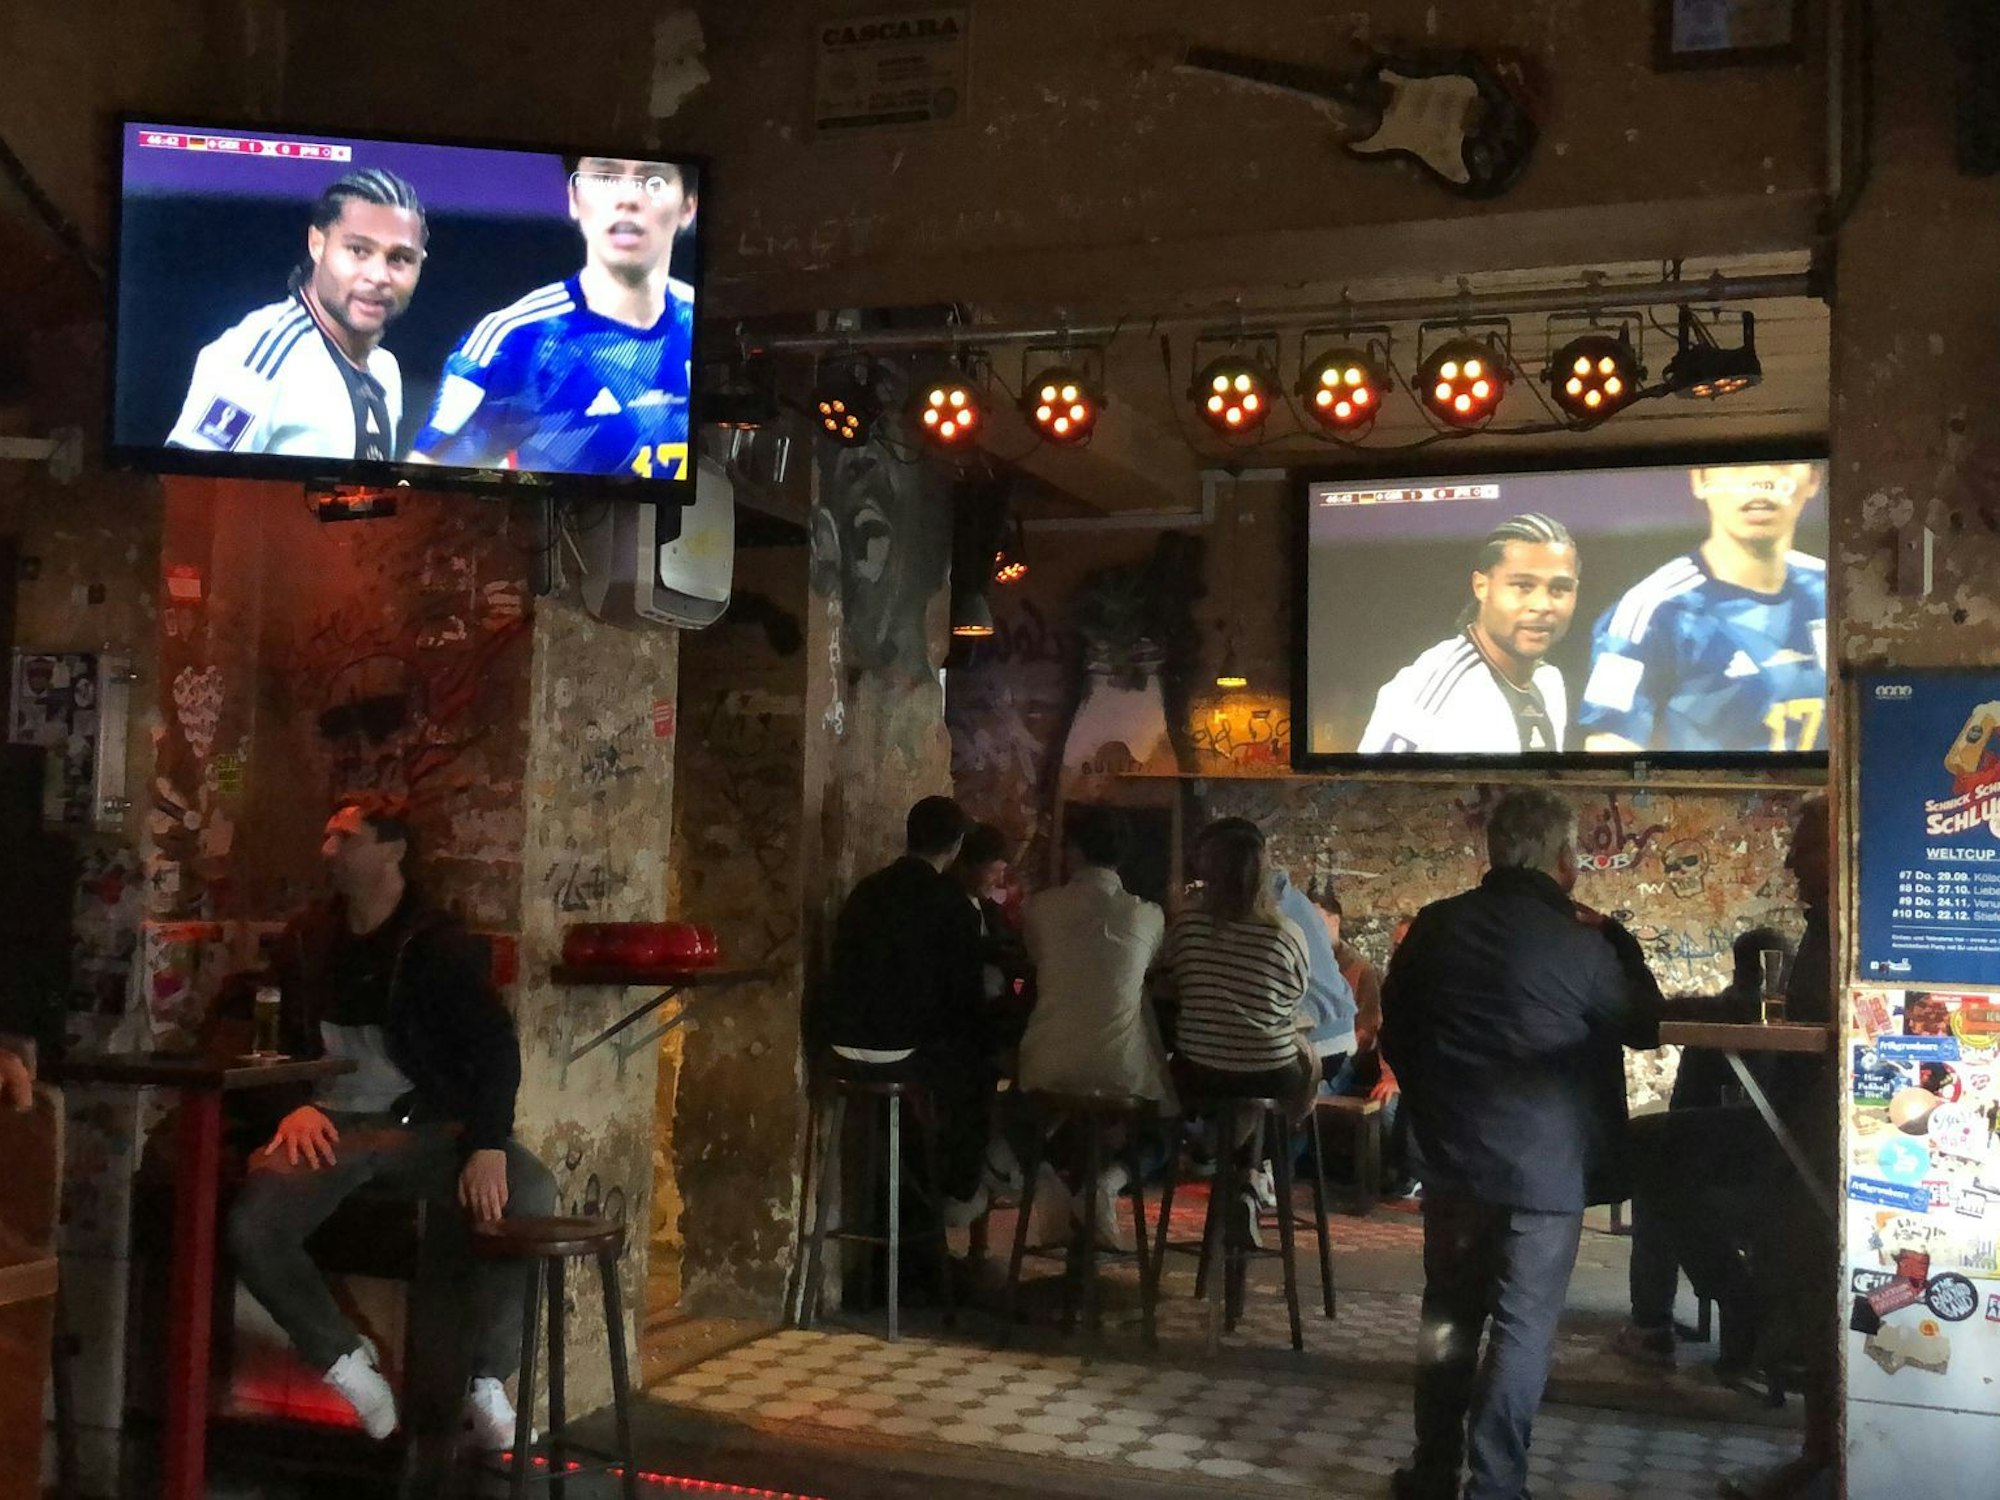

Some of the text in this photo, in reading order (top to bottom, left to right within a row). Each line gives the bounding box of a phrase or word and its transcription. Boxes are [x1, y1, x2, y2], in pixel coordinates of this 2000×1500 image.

[218, 139, 240, 151] GER
[1762, 697, 1825, 752] 17
[1926, 847, 1996, 860] WELTCUP
[1899, 870, 1912, 880] #7
[1915, 870, 1935, 880] Do.
[1915, 883, 1935, 893] Do.
[1937, 884, 1971, 895] 27.10.
[1915, 896, 1935, 906] Do.
[1937, 897, 1971, 908] 24.11.
[1915, 909, 1935, 919] Do.
[1937, 910, 1971, 920] 22.12.
